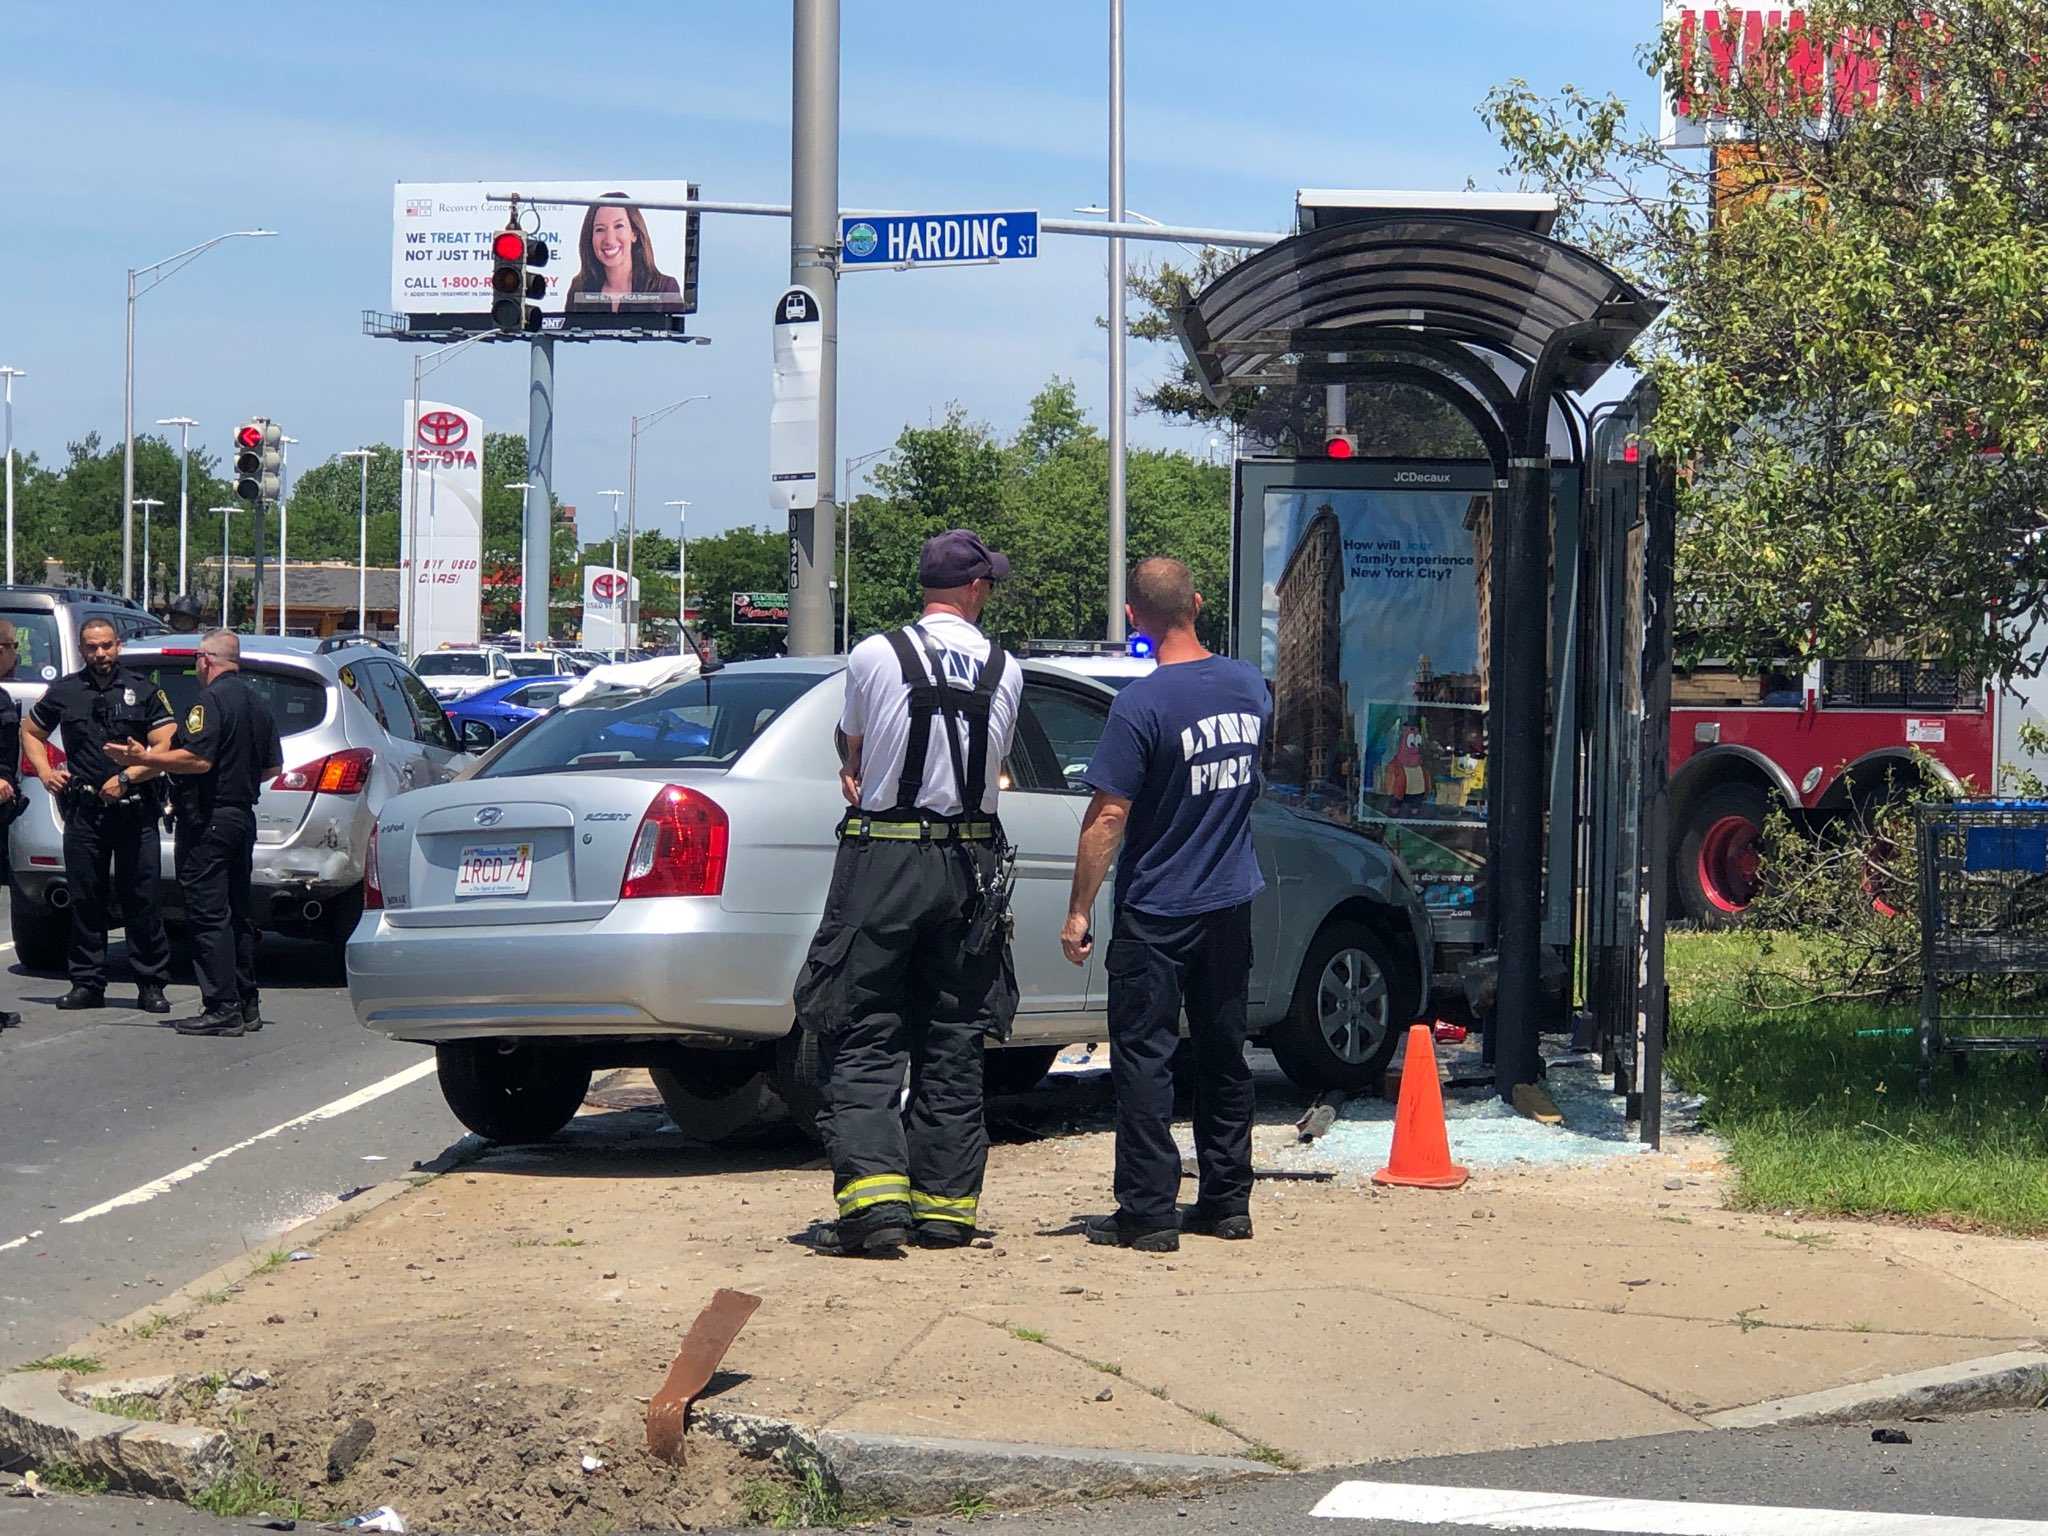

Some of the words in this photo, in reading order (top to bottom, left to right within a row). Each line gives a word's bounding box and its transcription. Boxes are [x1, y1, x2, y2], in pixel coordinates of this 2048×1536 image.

[480, 203, 512, 212] Center
[406, 232, 426, 243] WE
[430, 232, 470, 243] TREAT
[474, 232, 492, 243] TH
[887, 217, 1008, 260] HARDING
[1018, 235, 1035, 256] ST
[405, 250, 433, 261] NOT
[436, 250, 469, 261] JUST
[404, 277, 437, 289] CALL
[1393, 472, 1450, 483] JCDecaux
[1343, 540, 1373, 550] How
[1376, 540, 1401, 550] will
[451, 559, 477, 569] USED
[1355, 553, 1397, 566] family
[1399, 554, 1474, 567] experience
[1351, 567, 1381, 578] New
[1385, 567, 1414, 578] York
[1417, 567, 1452, 581] City?
[1181, 712, 1262, 762] LYNN
[1191, 754, 1252, 796] FIRE
